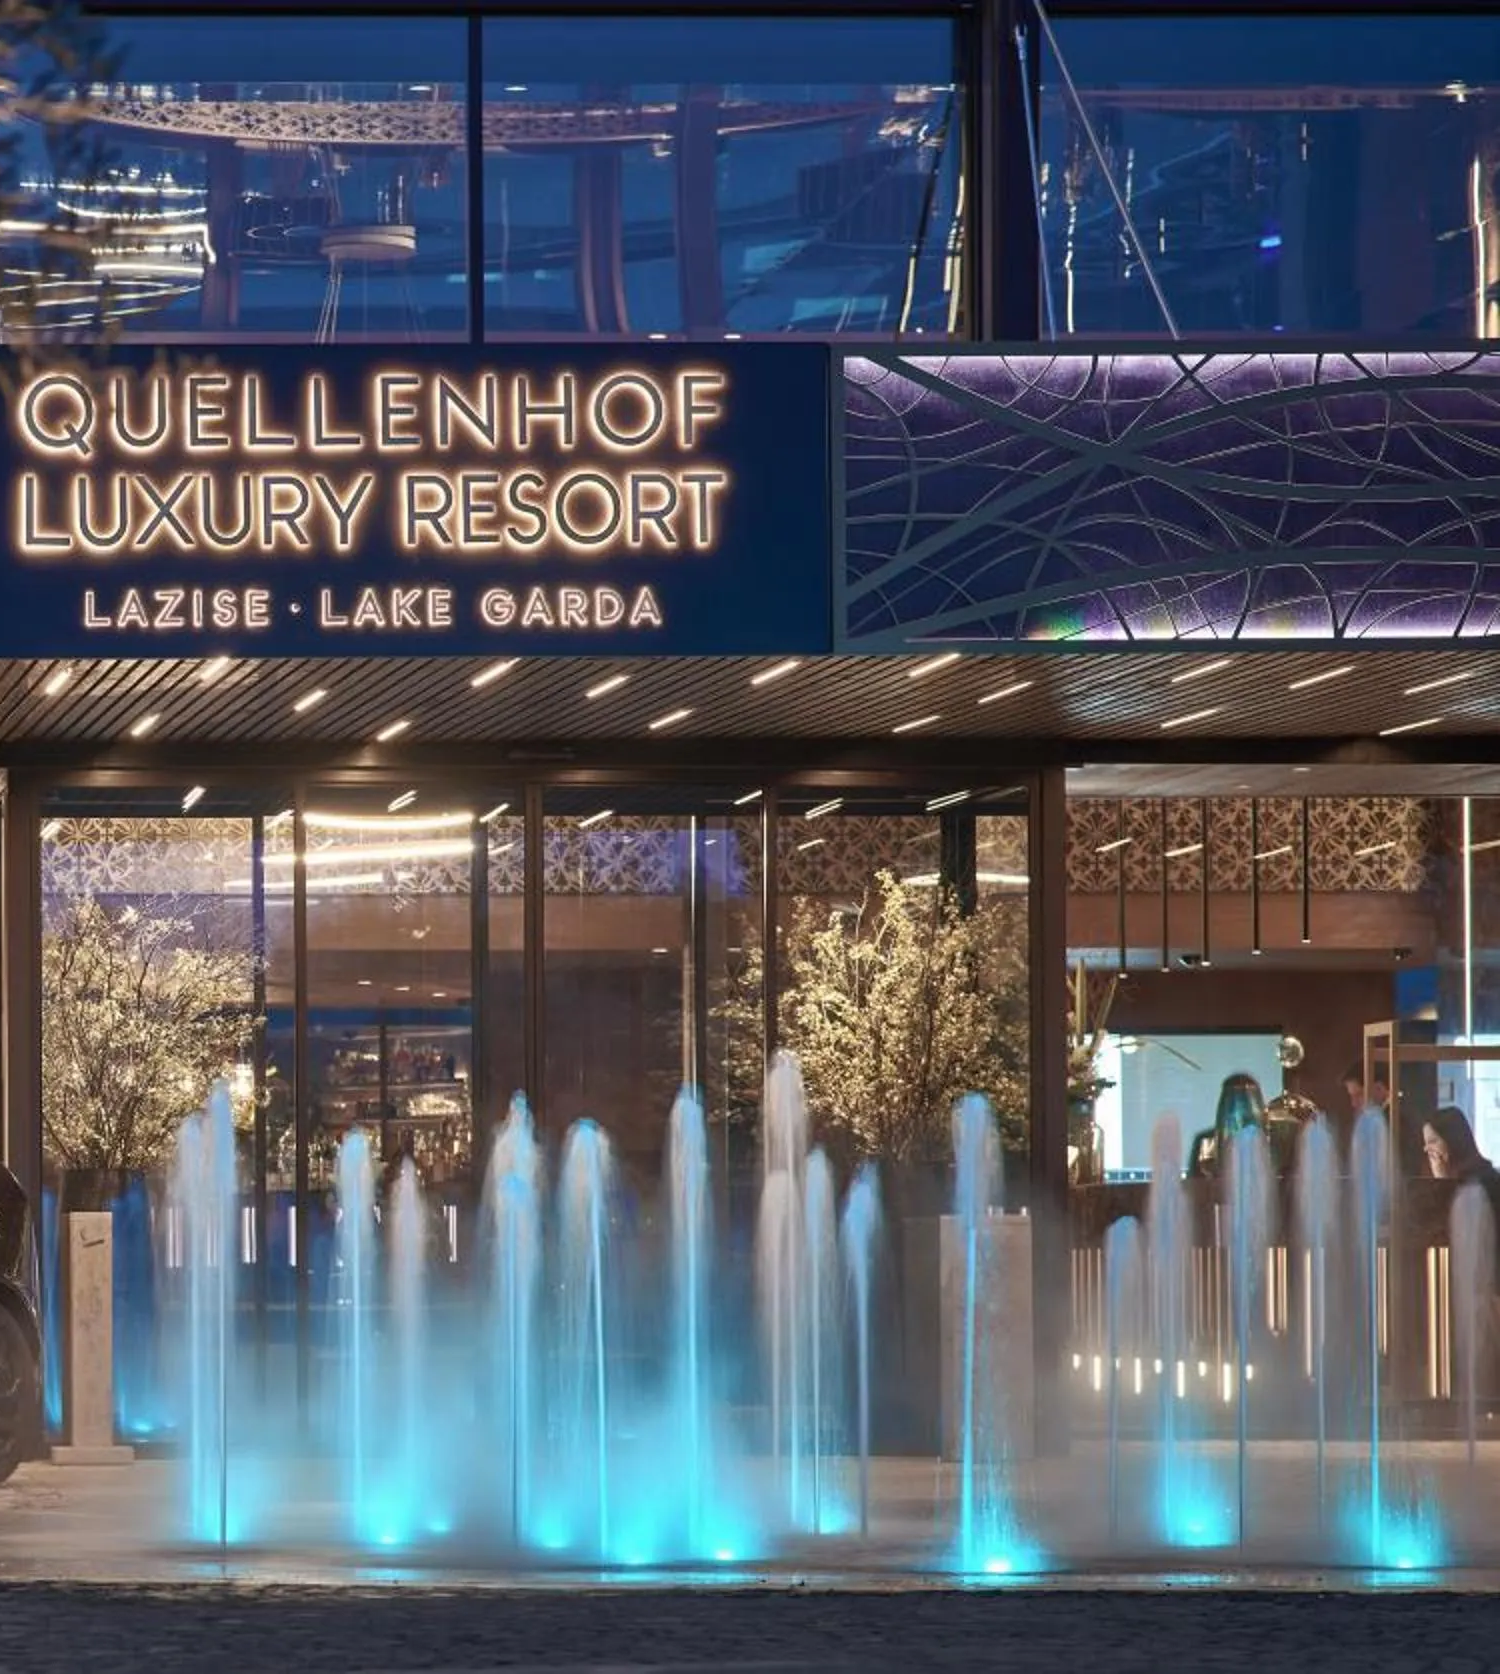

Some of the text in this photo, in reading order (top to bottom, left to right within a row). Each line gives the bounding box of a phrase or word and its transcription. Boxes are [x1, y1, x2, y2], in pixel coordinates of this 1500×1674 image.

[23, 374, 724, 455] QUELLENHOF
[24, 472, 725, 546] LUXURY RESORT
[84, 589, 270, 627] LAZISE
[321, 588, 452, 626] LAKE
[481, 587, 662, 626] GARDA
